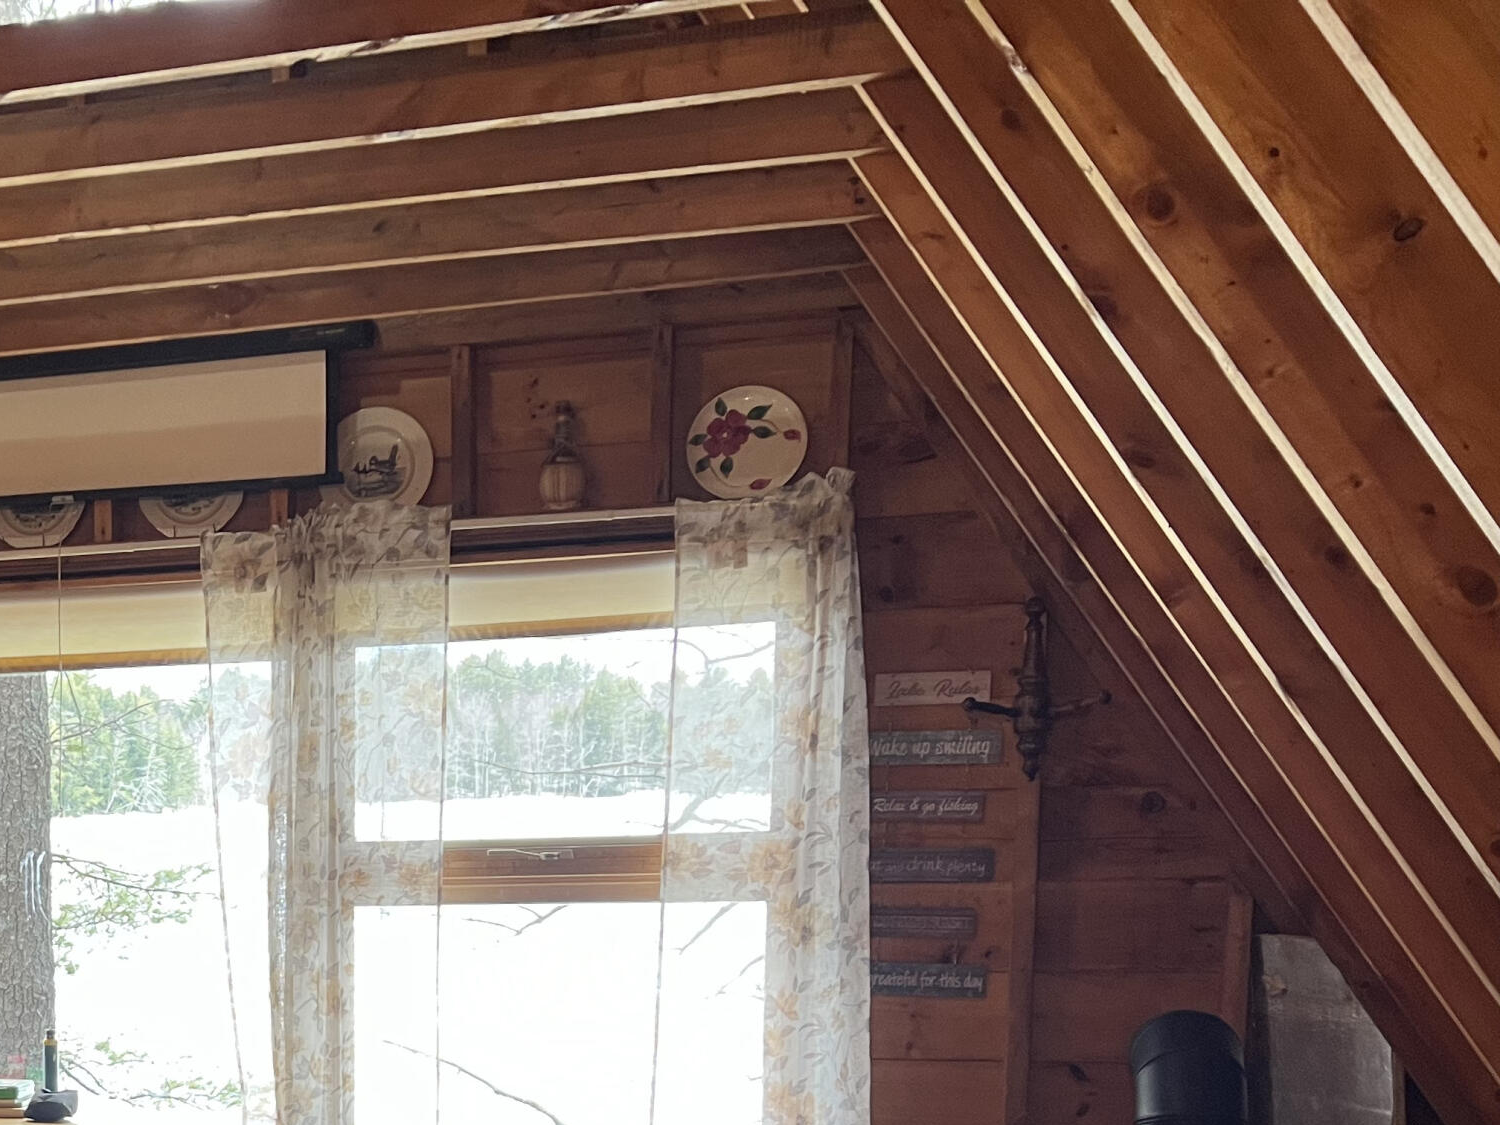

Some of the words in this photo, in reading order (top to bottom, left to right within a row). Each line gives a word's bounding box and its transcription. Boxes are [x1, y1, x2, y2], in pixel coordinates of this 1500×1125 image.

[912, 741, 930, 758] up
[935, 736, 990, 758] smiling
[909, 797, 918, 811] &
[906, 856, 944, 873] drink
[871, 970, 917, 989] rateful
[919, 970, 936, 991] for
[940, 971, 961, 988] this
[963, 971, 983, 992] day
